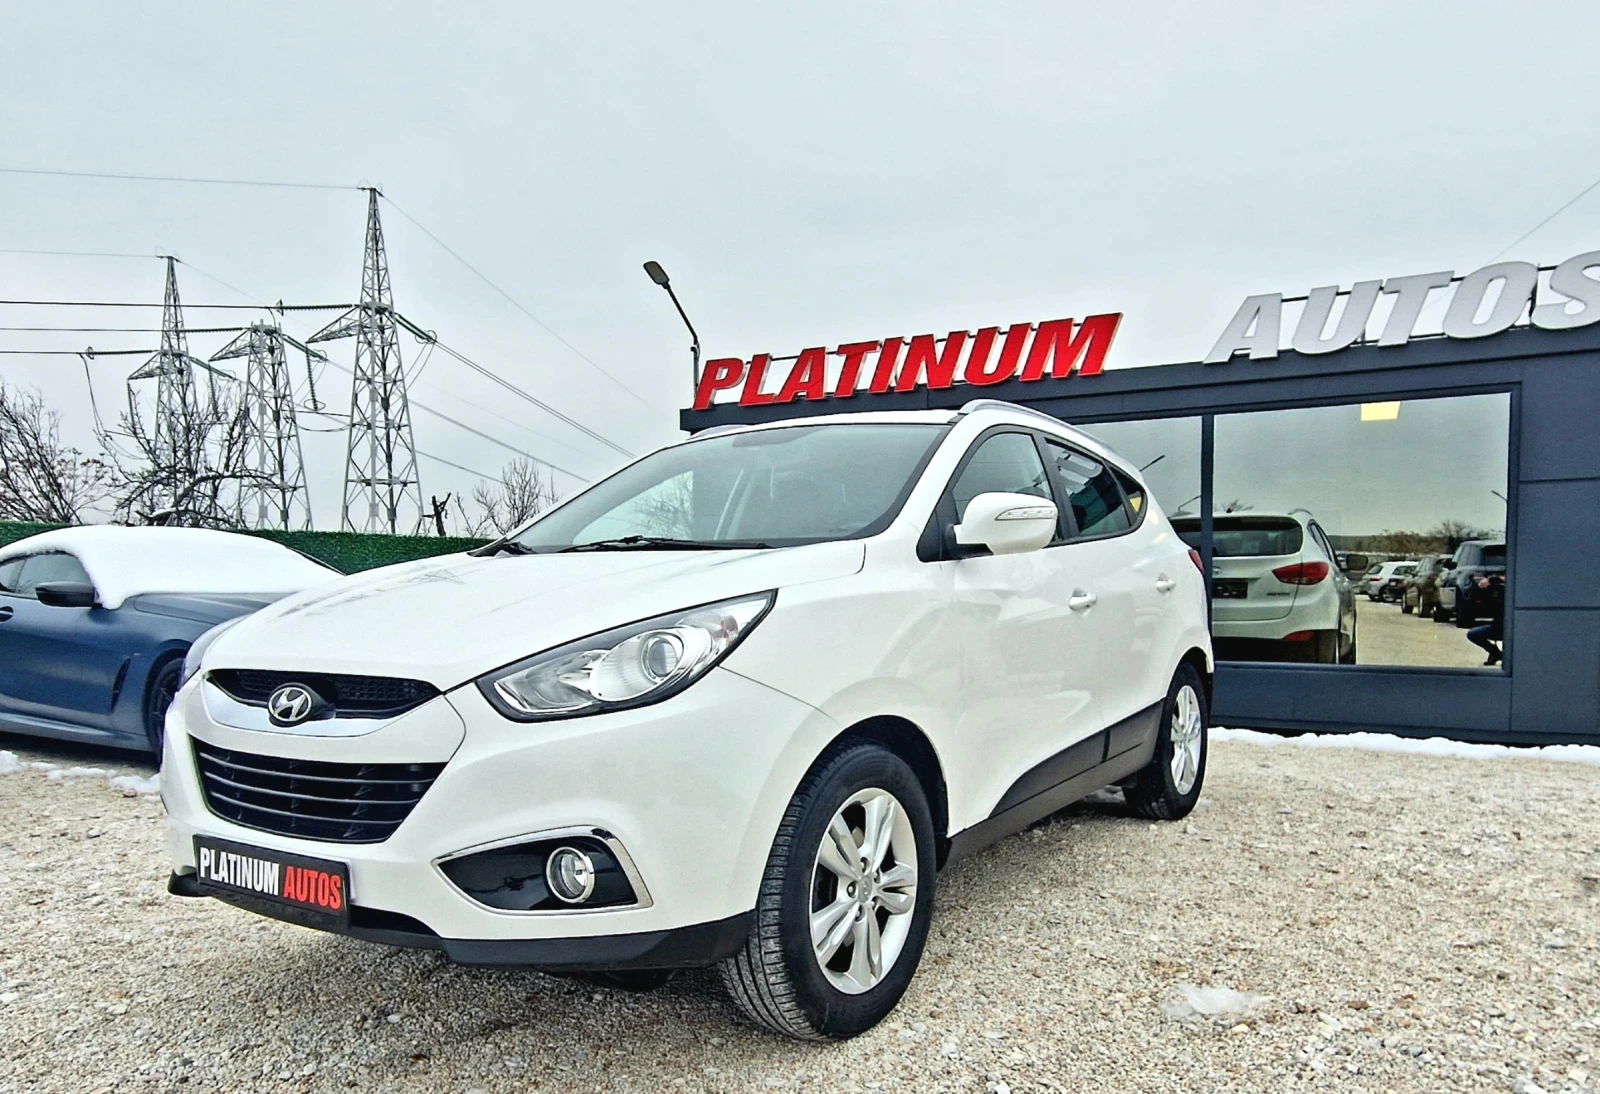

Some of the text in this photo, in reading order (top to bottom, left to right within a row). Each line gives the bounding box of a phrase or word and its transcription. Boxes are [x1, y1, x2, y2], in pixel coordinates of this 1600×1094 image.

[691, 250, 1600, 411] PLATINUM AUTOS
[200, 846, 342, 911] PLATINUM AUTOS
